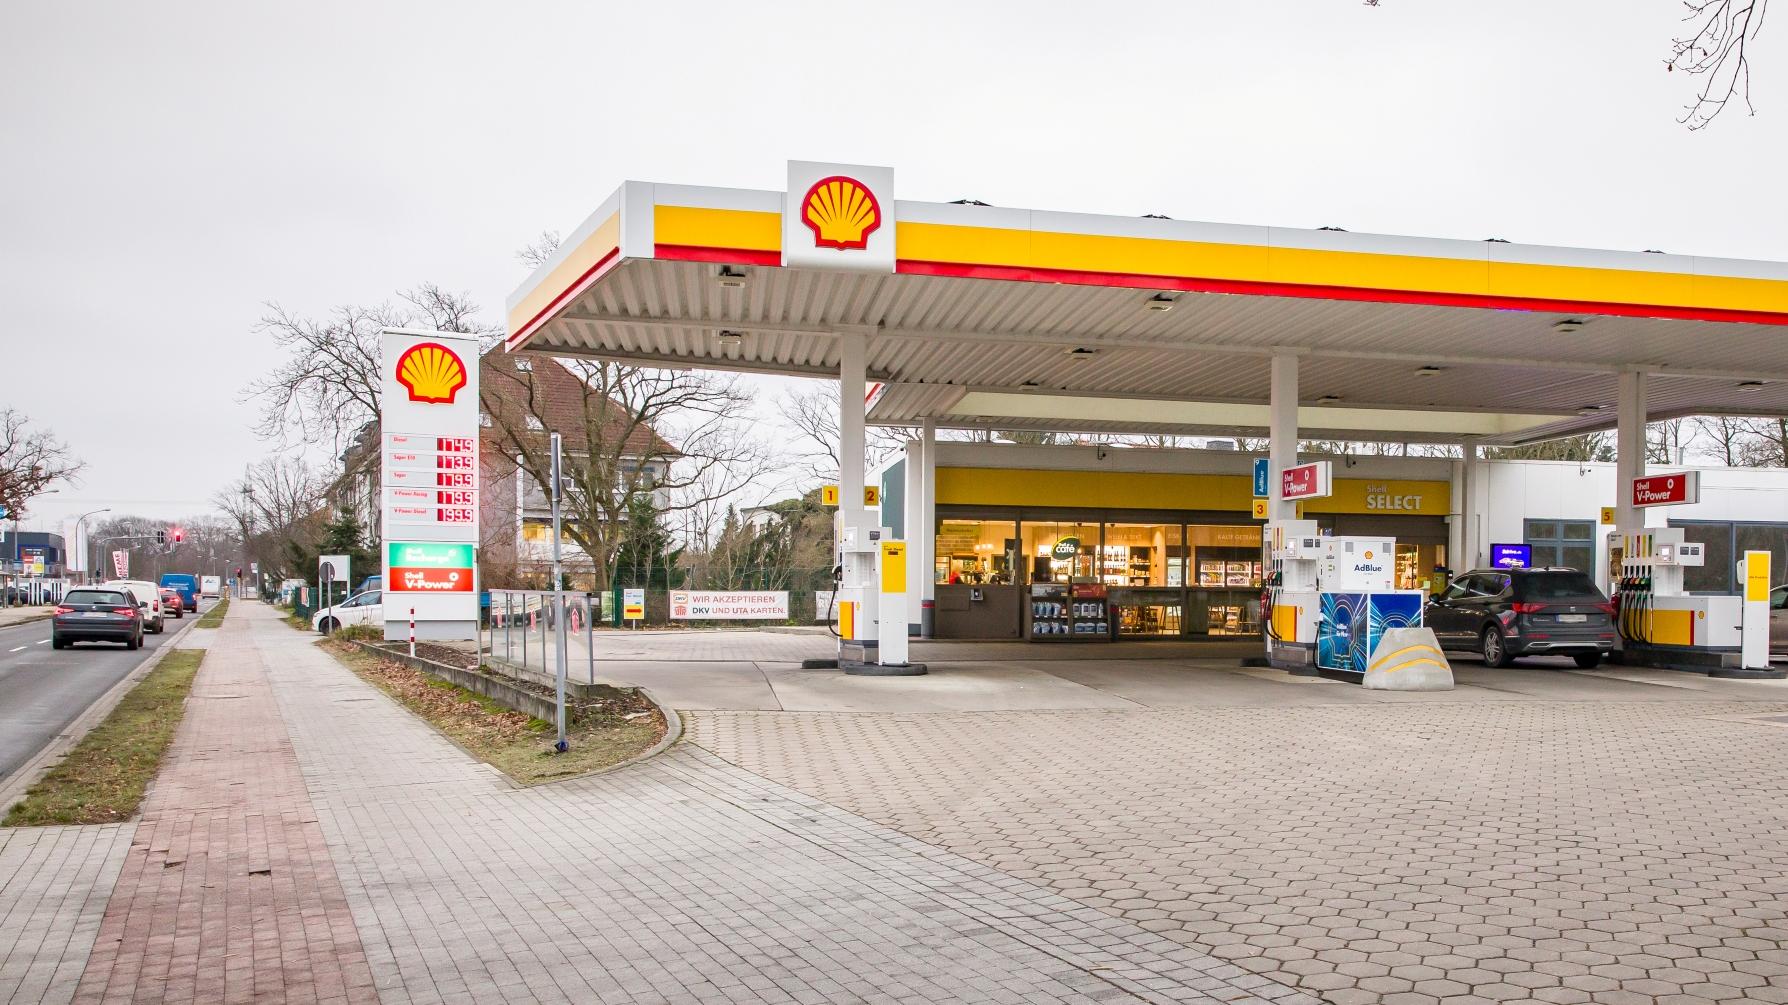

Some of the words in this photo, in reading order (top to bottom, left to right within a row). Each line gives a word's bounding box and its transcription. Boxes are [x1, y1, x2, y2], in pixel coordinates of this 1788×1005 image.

[1284, 482, 1308, 495] V-Power
[1636, 481, 1650, 490] Shell
[827, 491, 833, 501] 1
[866, 491, 875, 501] 2
[1636, 490, 1671, 502] V-Power
[1366, 494, 1423, 510] SELECT
[1256, 504, 1264, 515] 3
[1603, 512, 1610, 521] 5
[1353, 563, 1383, 572] AdBlue
[404, 572, 424, 580] Shell
[404, 580, 456, 589] V-Power
[692, 595, 710, 603] WIR
[712, 595, 776, 603] AKZEPTIEREN
